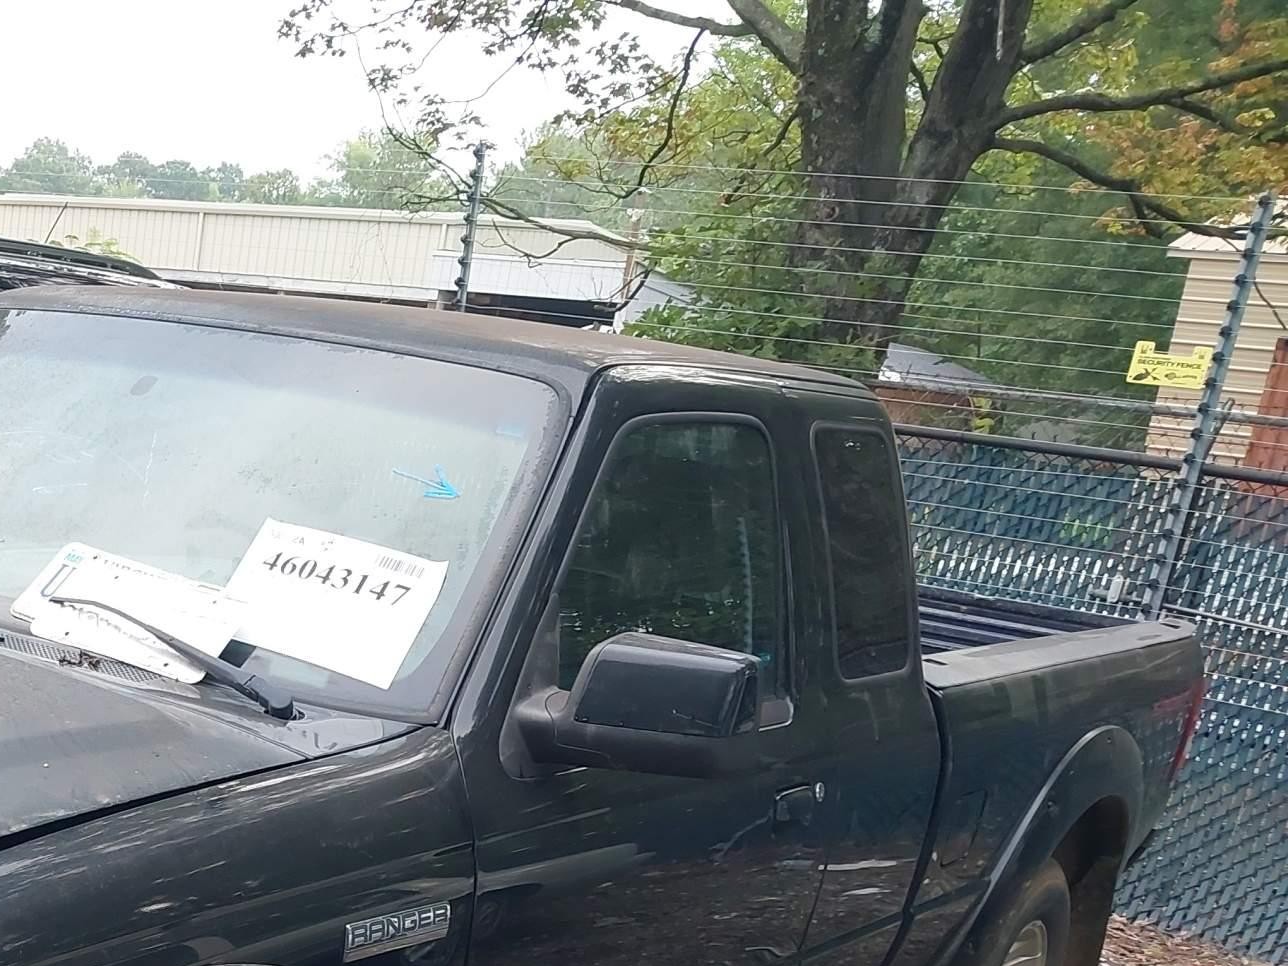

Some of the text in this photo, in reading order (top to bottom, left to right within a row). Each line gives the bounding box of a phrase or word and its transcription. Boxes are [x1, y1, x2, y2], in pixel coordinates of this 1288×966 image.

[1137, 358, 1202, 370] SECURITY FENCE
[262, 551, 412, 606] 46043147
[345, 902, 451, 950] RANGER
